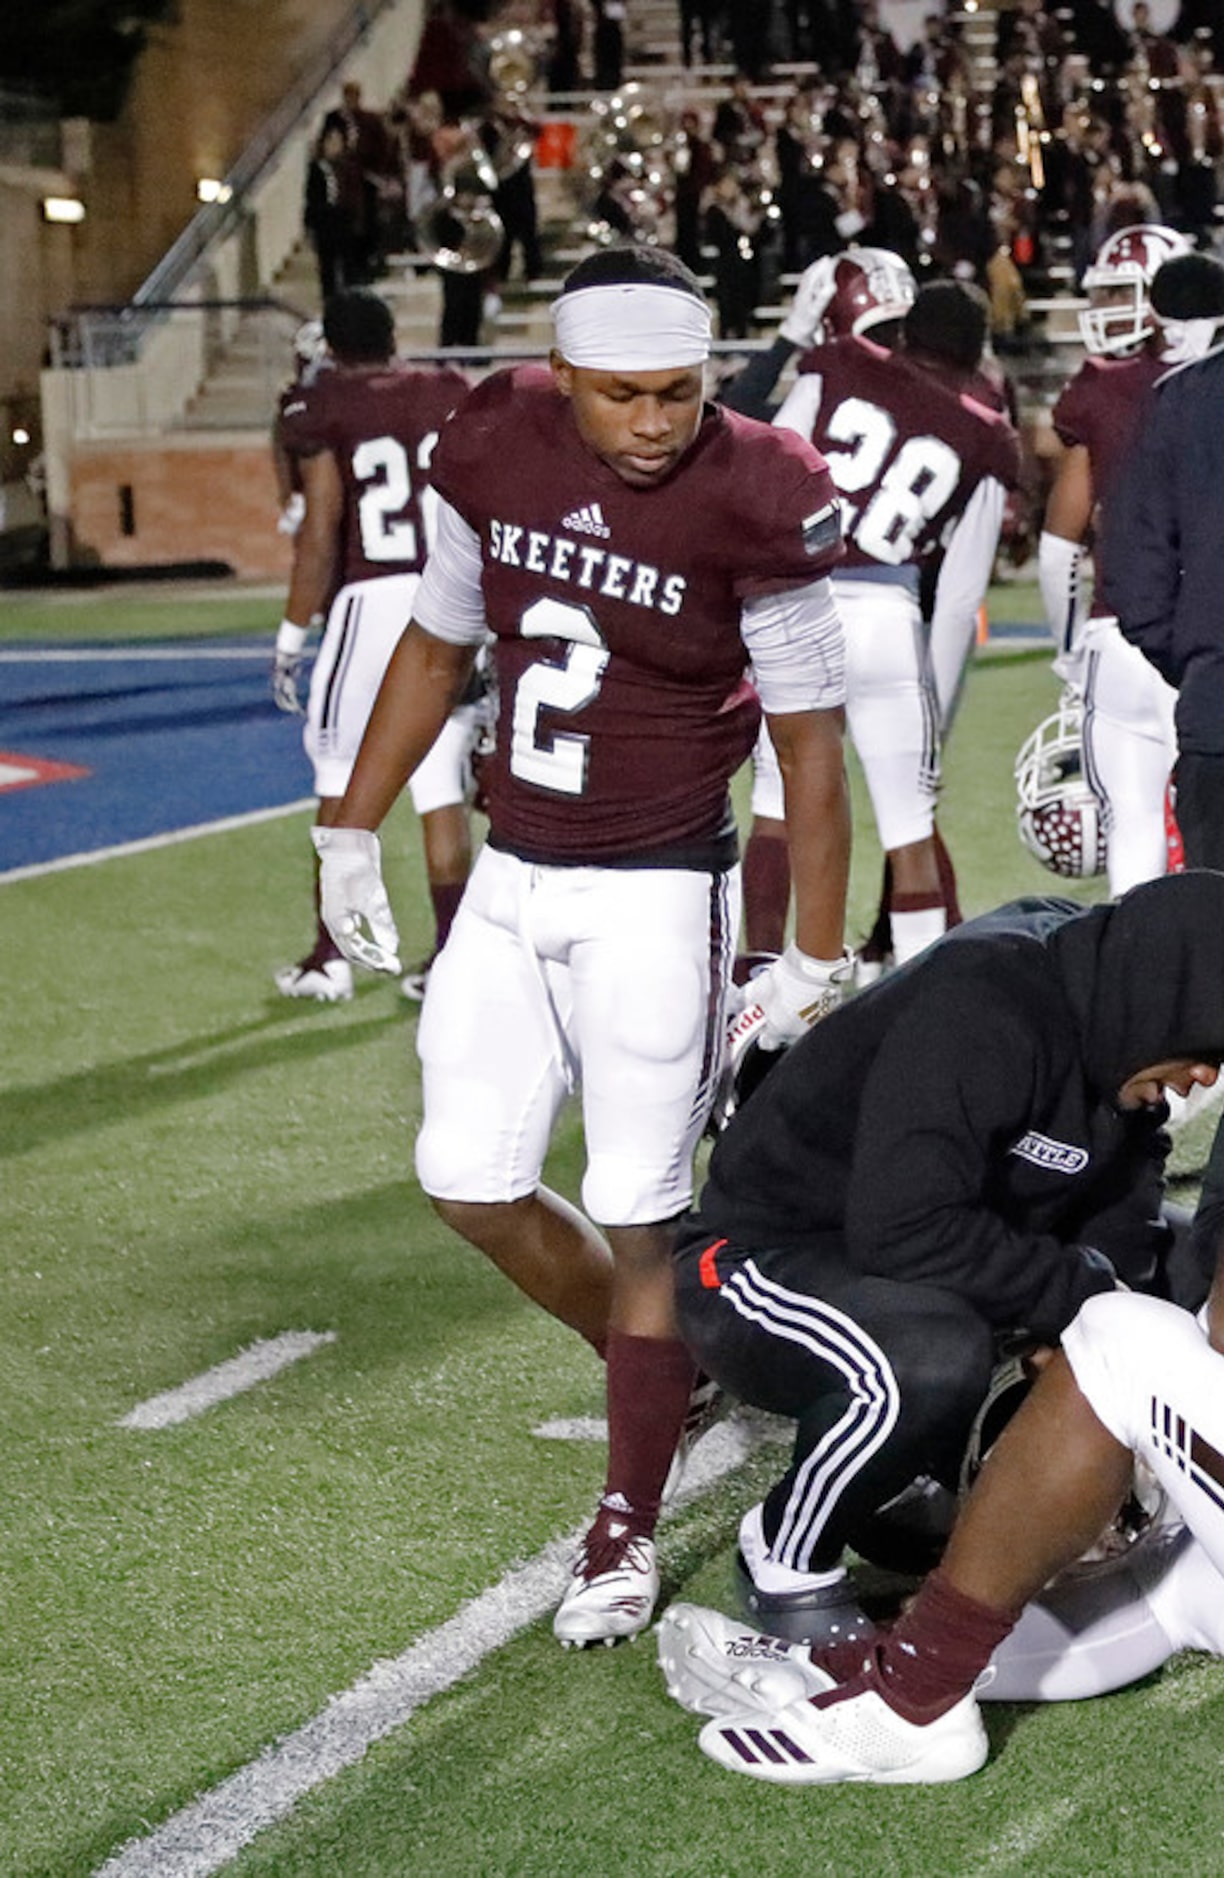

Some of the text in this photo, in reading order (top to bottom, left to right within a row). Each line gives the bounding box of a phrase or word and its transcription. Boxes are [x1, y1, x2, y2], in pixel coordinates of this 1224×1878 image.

[826, 397, 961, 566] 28
[490, 519, 687, 615] SKEETERS
[510, 597, 611, 796] 2
[1016, 1136, 1082, 1168] ATTLE
